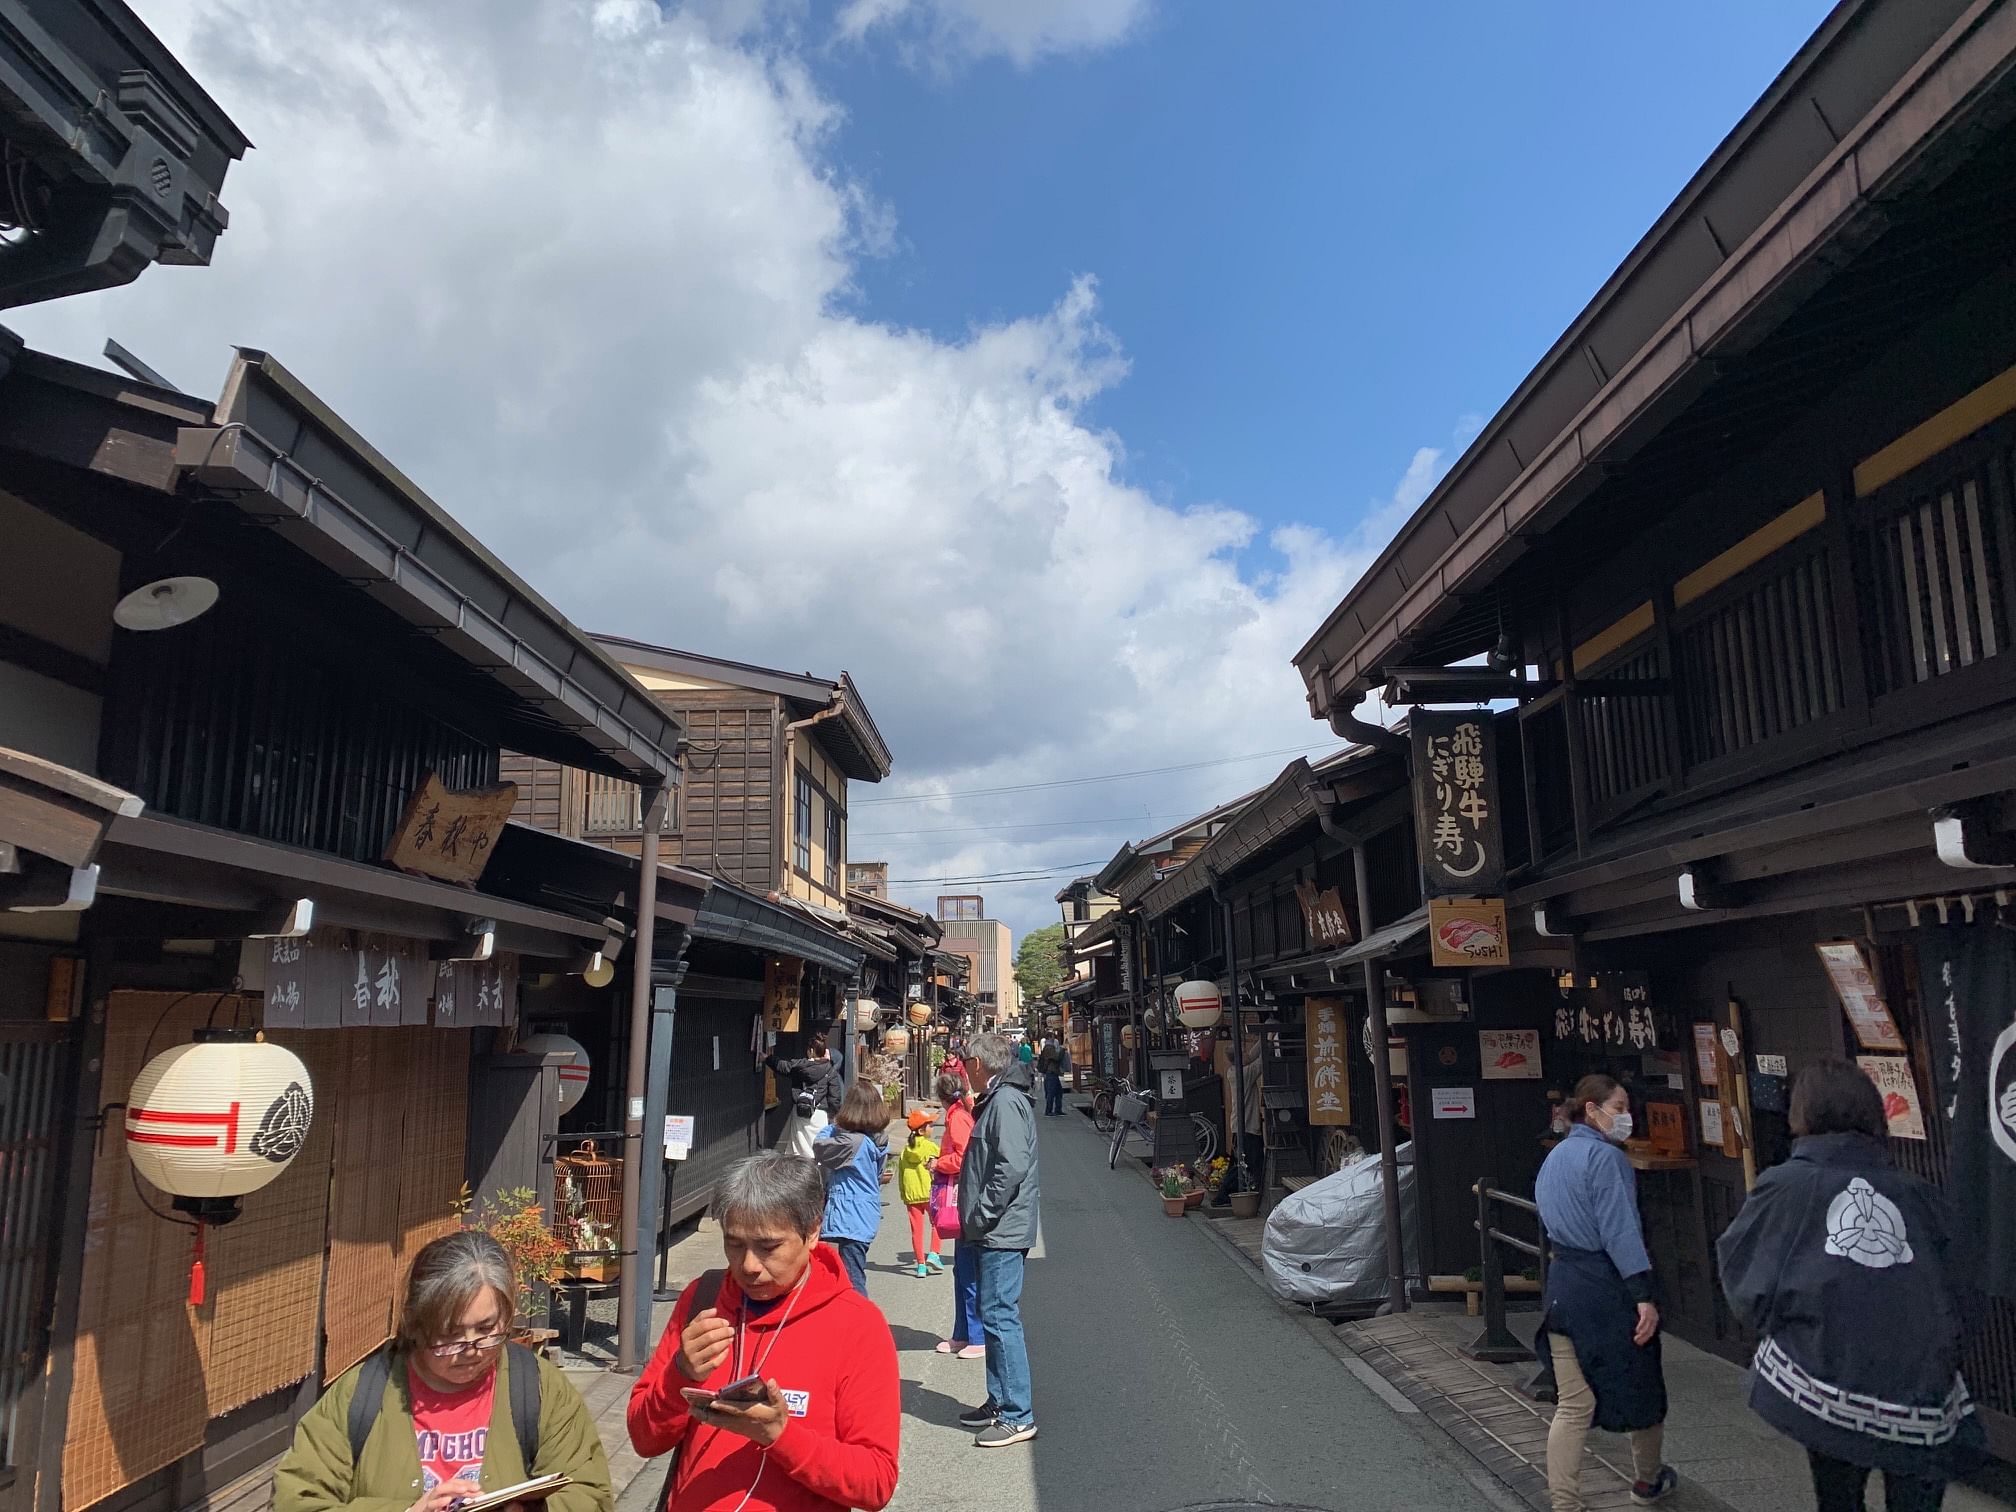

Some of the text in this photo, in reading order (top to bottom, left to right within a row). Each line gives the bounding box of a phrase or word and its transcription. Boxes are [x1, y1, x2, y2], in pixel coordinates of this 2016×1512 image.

[1452, 723, 1488, 830] 飛騨牛
[353, 950, 400, 1010] 春秋
